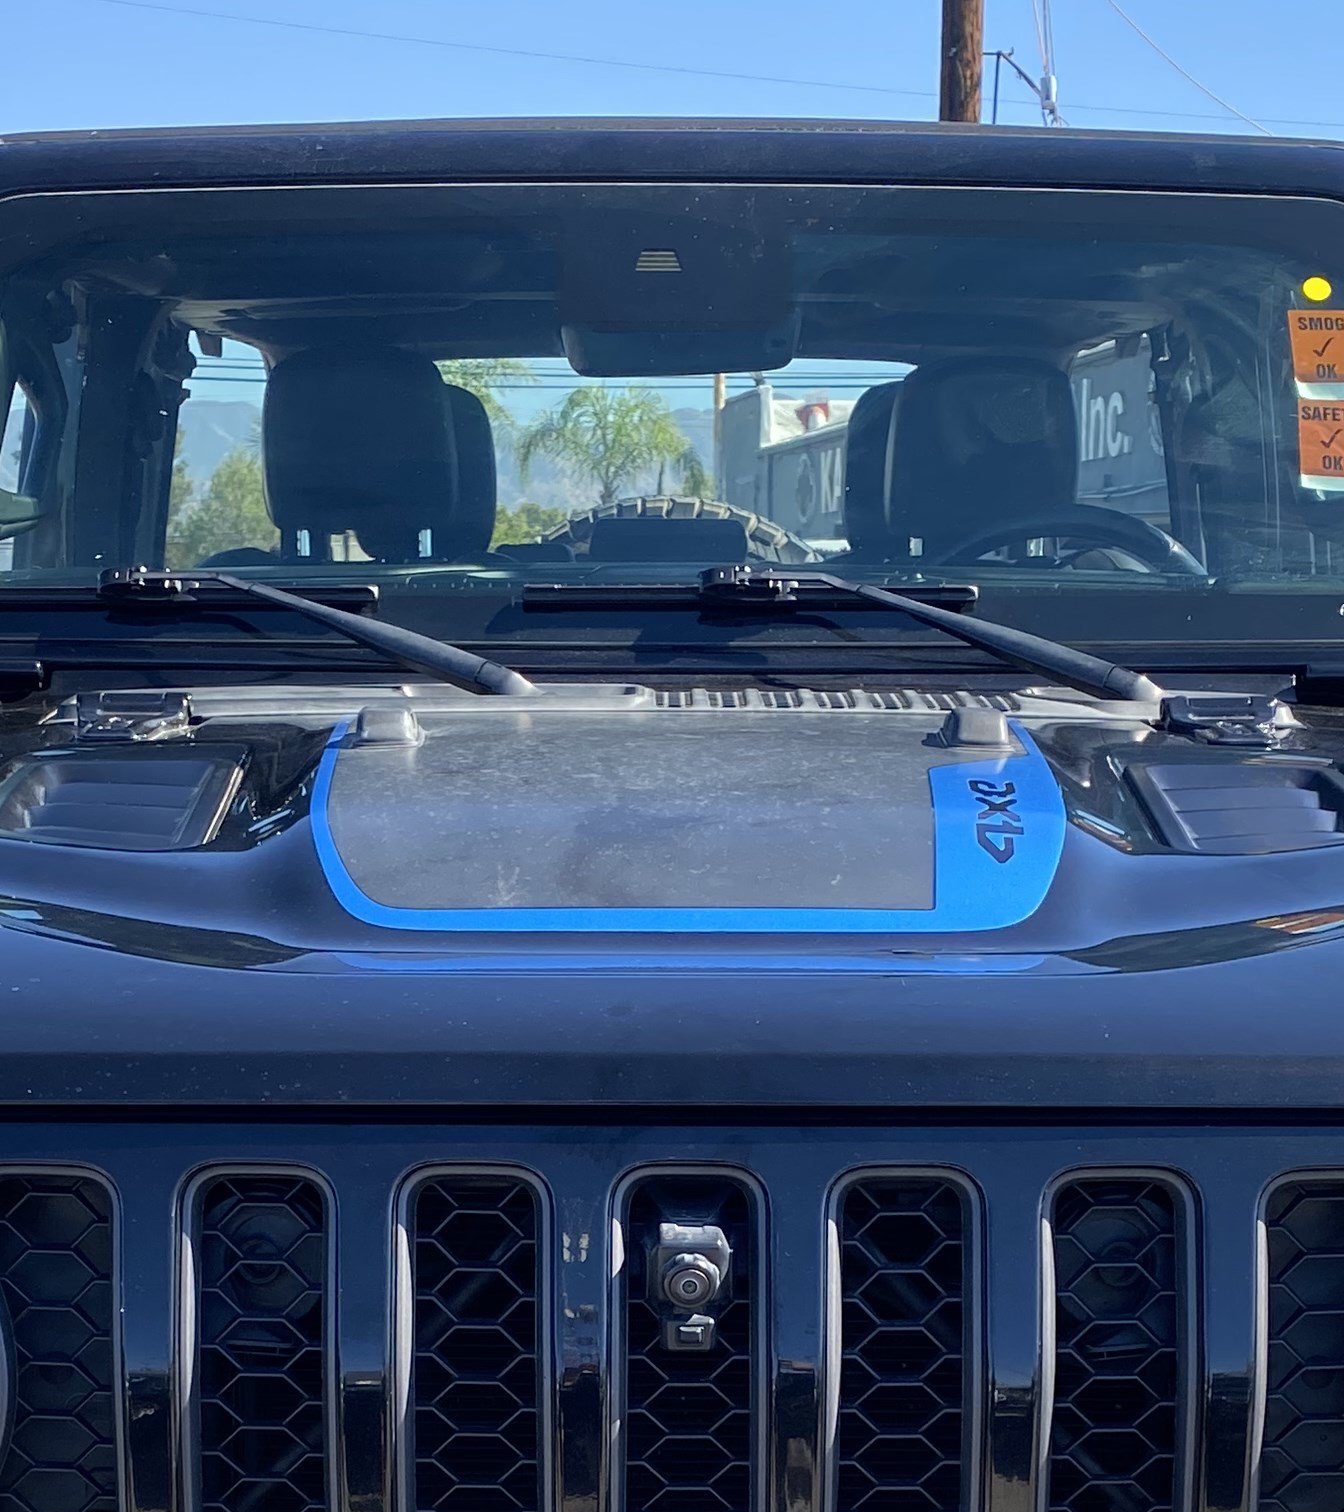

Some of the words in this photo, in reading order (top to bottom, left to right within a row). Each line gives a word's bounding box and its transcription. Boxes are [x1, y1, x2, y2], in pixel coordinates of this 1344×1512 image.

[1316, 363, 1338, 379] OK
[1080, 378, 1130, 461] Inc.
[1322, 455, 1344, 471] OK
